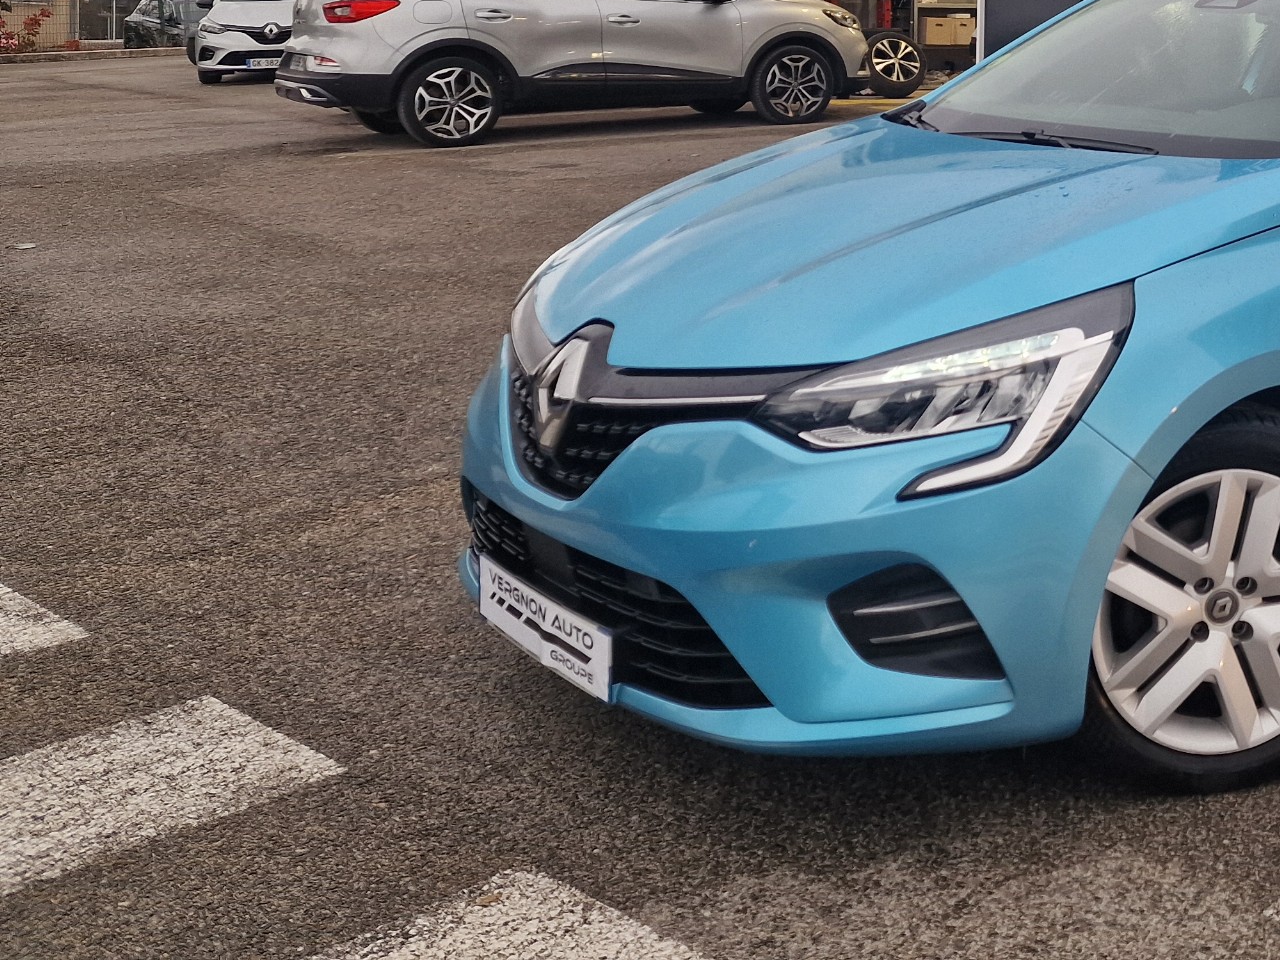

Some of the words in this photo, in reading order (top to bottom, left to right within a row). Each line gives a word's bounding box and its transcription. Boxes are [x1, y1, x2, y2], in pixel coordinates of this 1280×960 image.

[487, 567, 548, 623] VERGNON
[550, 613, 594, 651] AUTO
[549, 649, 594, 685] GROUPE
